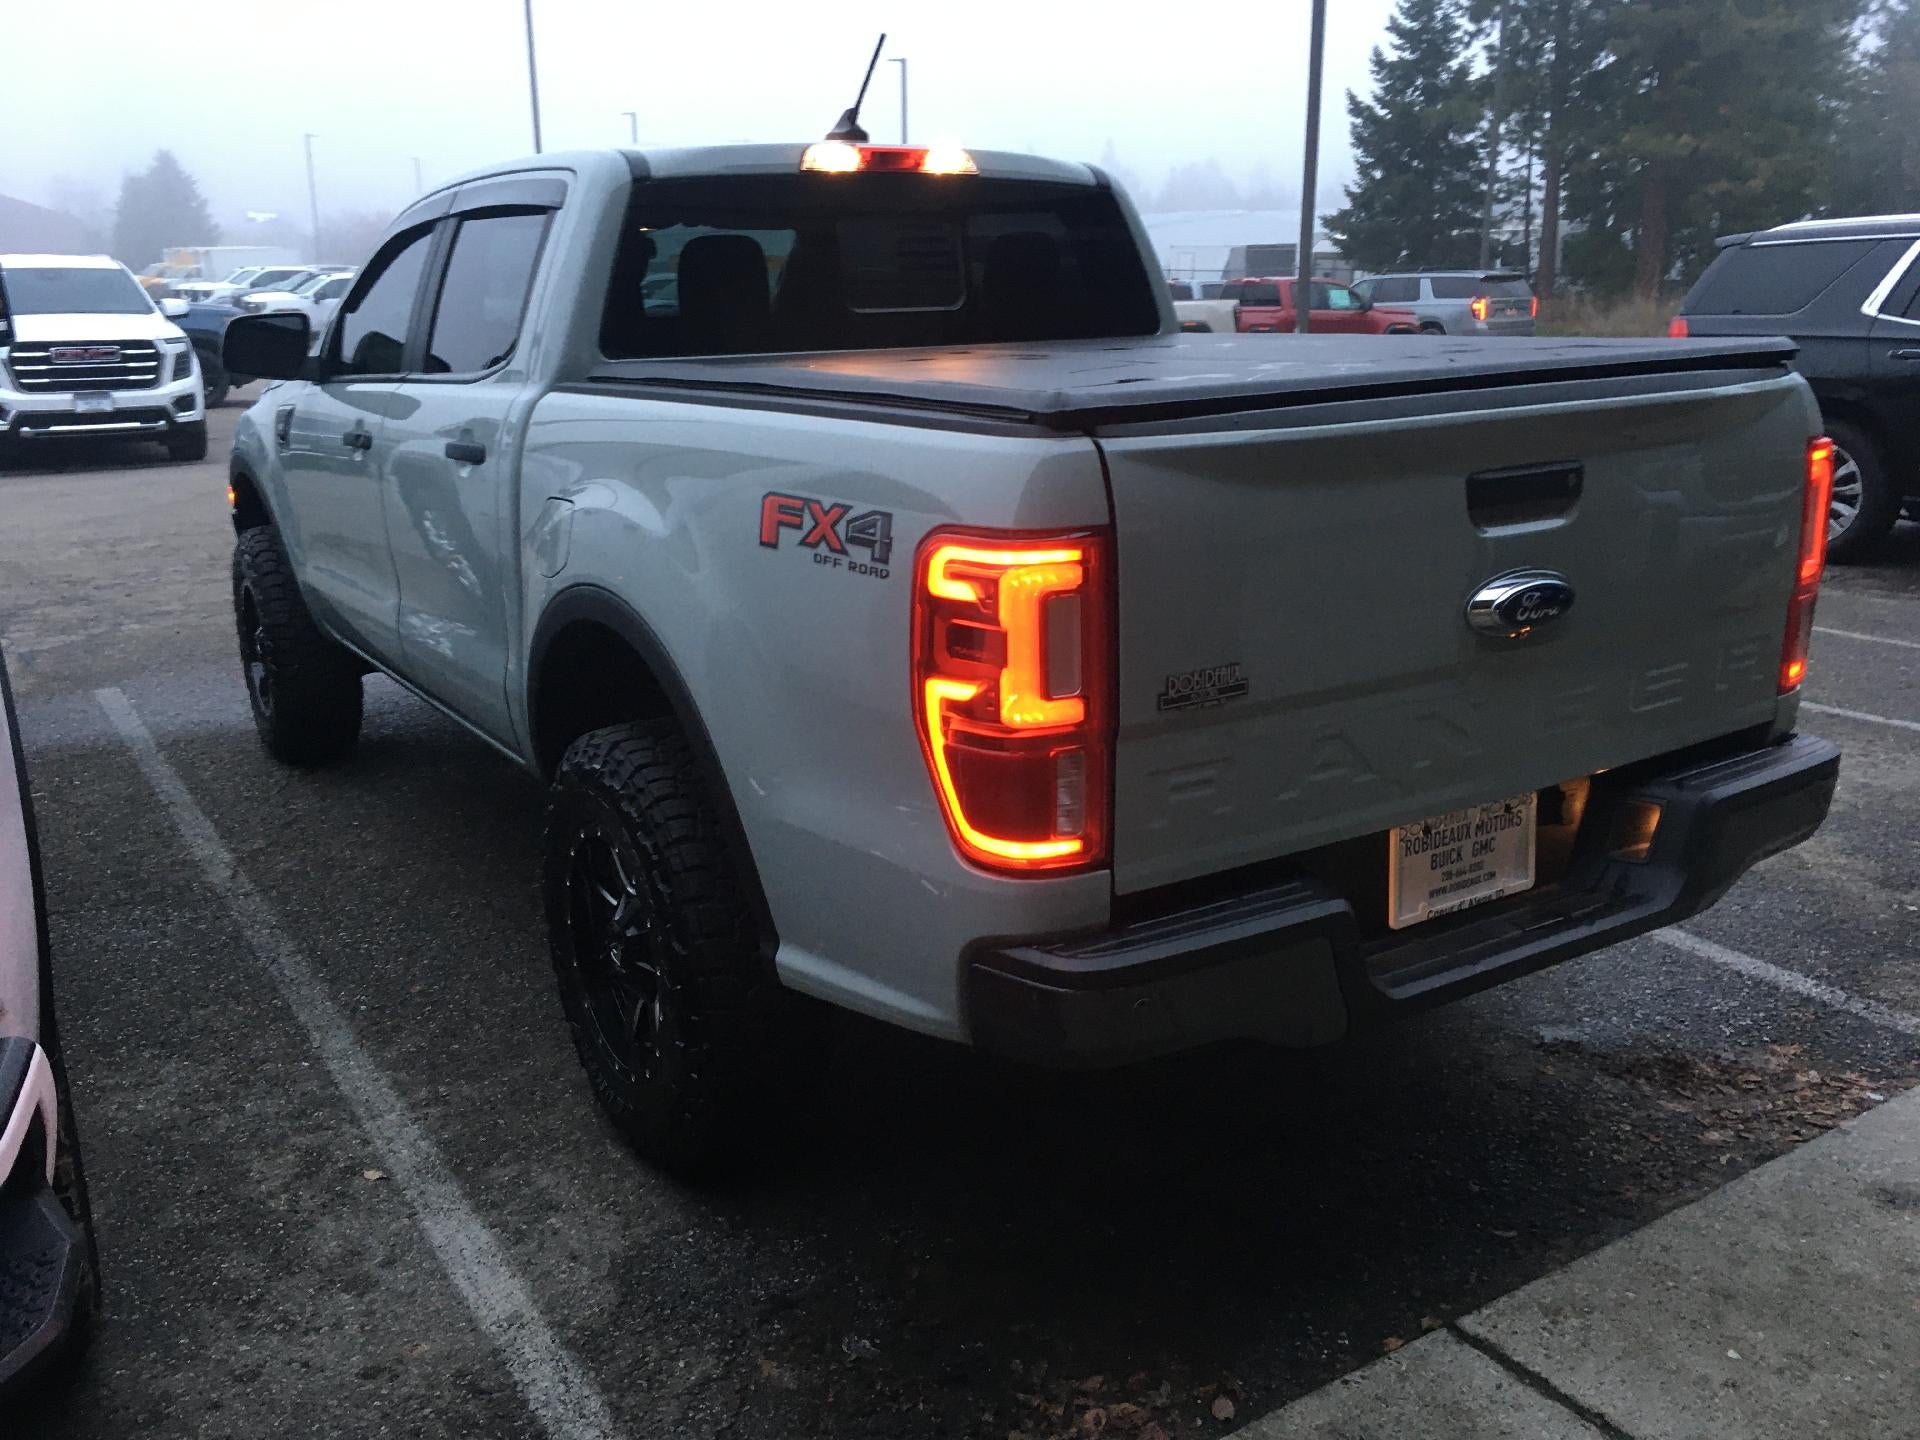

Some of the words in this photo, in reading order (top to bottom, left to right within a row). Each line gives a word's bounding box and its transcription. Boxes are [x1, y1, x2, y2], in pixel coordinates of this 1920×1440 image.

[759, 491, 893, 565] FX4
[813, 552, 843, 569] OFF
[847, 561, 890, 580] ROAD
[1512, 590, 1566, 622] Ford
[1404, 821, 1472, 857] ROBIDEAUX
[1475, 809, 1523, 838] MOTORS
[1430, 847, 1463, 870] BUICK
[1472, 837, 1496, 858] GMC
